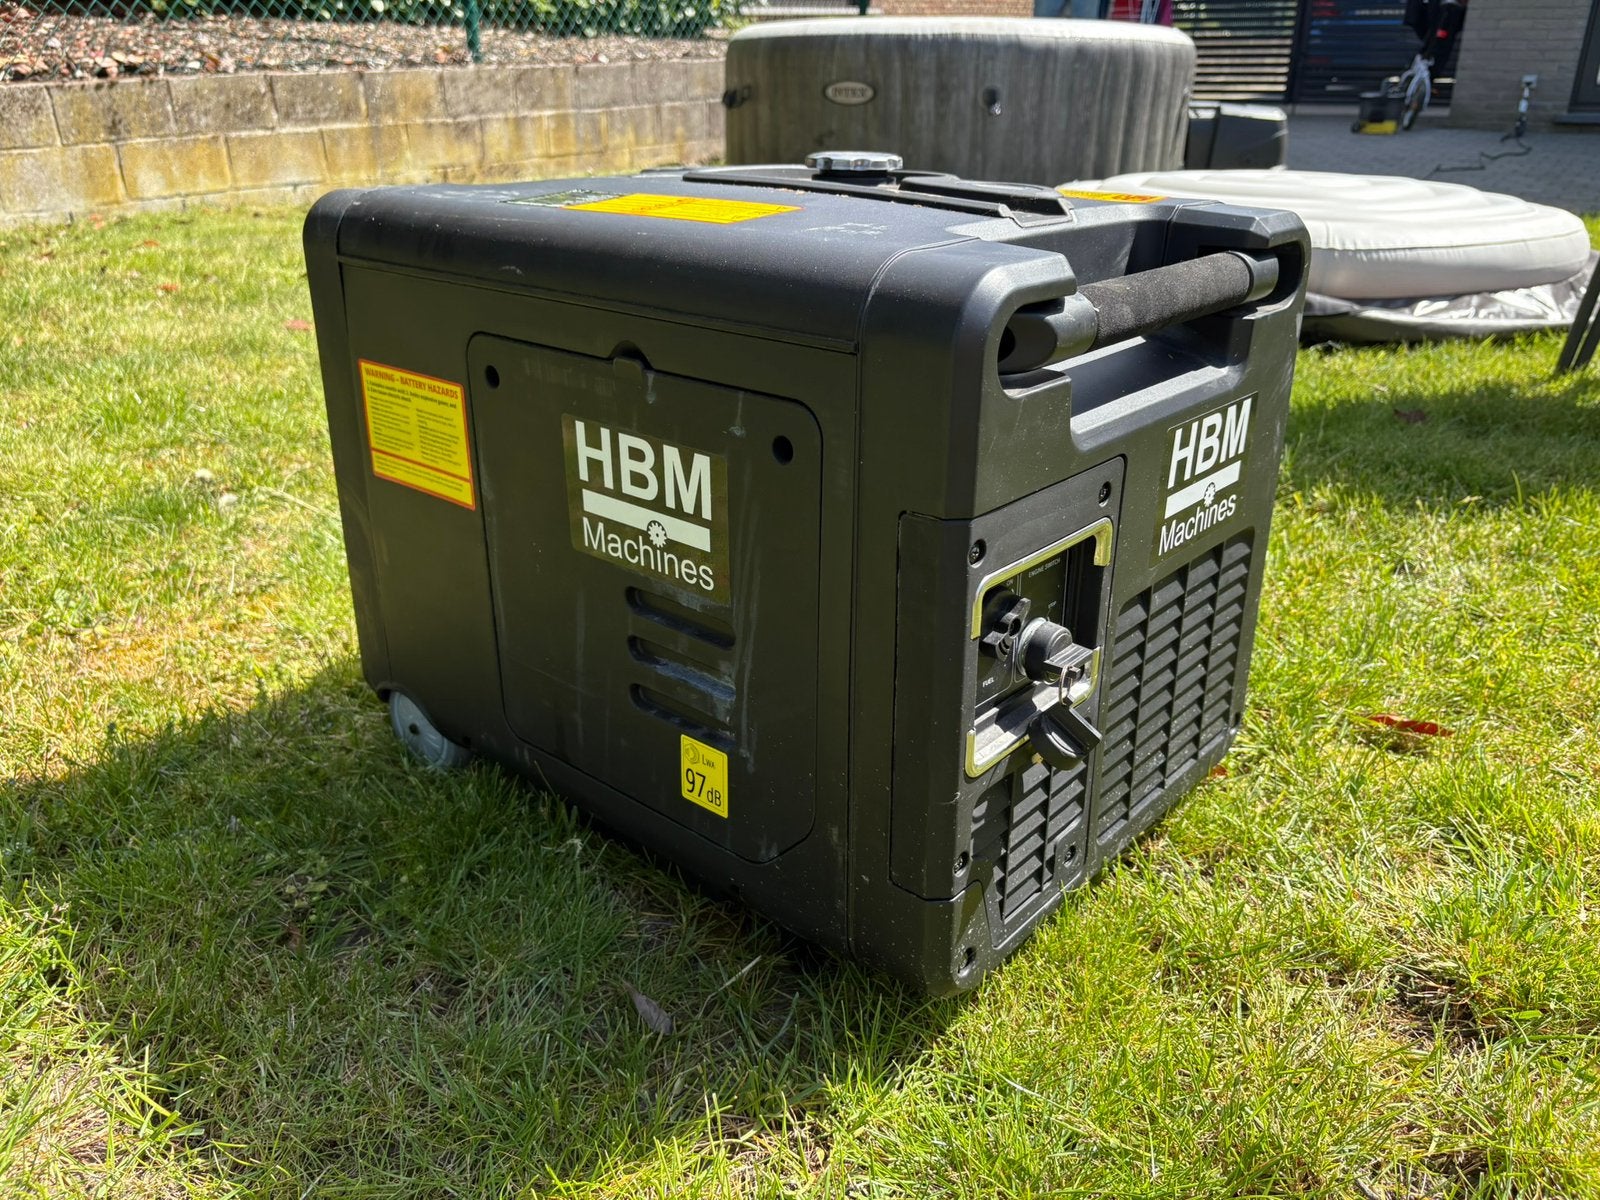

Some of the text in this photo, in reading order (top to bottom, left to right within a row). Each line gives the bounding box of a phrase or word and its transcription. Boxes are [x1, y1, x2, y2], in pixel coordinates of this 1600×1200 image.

[365, 367, 395, 382] WARNING
[400, 375, 427, 391] BATTERY
[428, 384, 458, 399] HAZARDS
[1168, 398, 1252, 489] HBM
[575, 420, 712, 521] HBM
[1158, 494, 1237, 556] Machines
[582, 517, 715, 591] Machines
[1028, 557, 1061, 578] ENGINE SWITCH
[982, 677, 995, 687] FUEL
[686, 768, 722, 807] 97 dB
